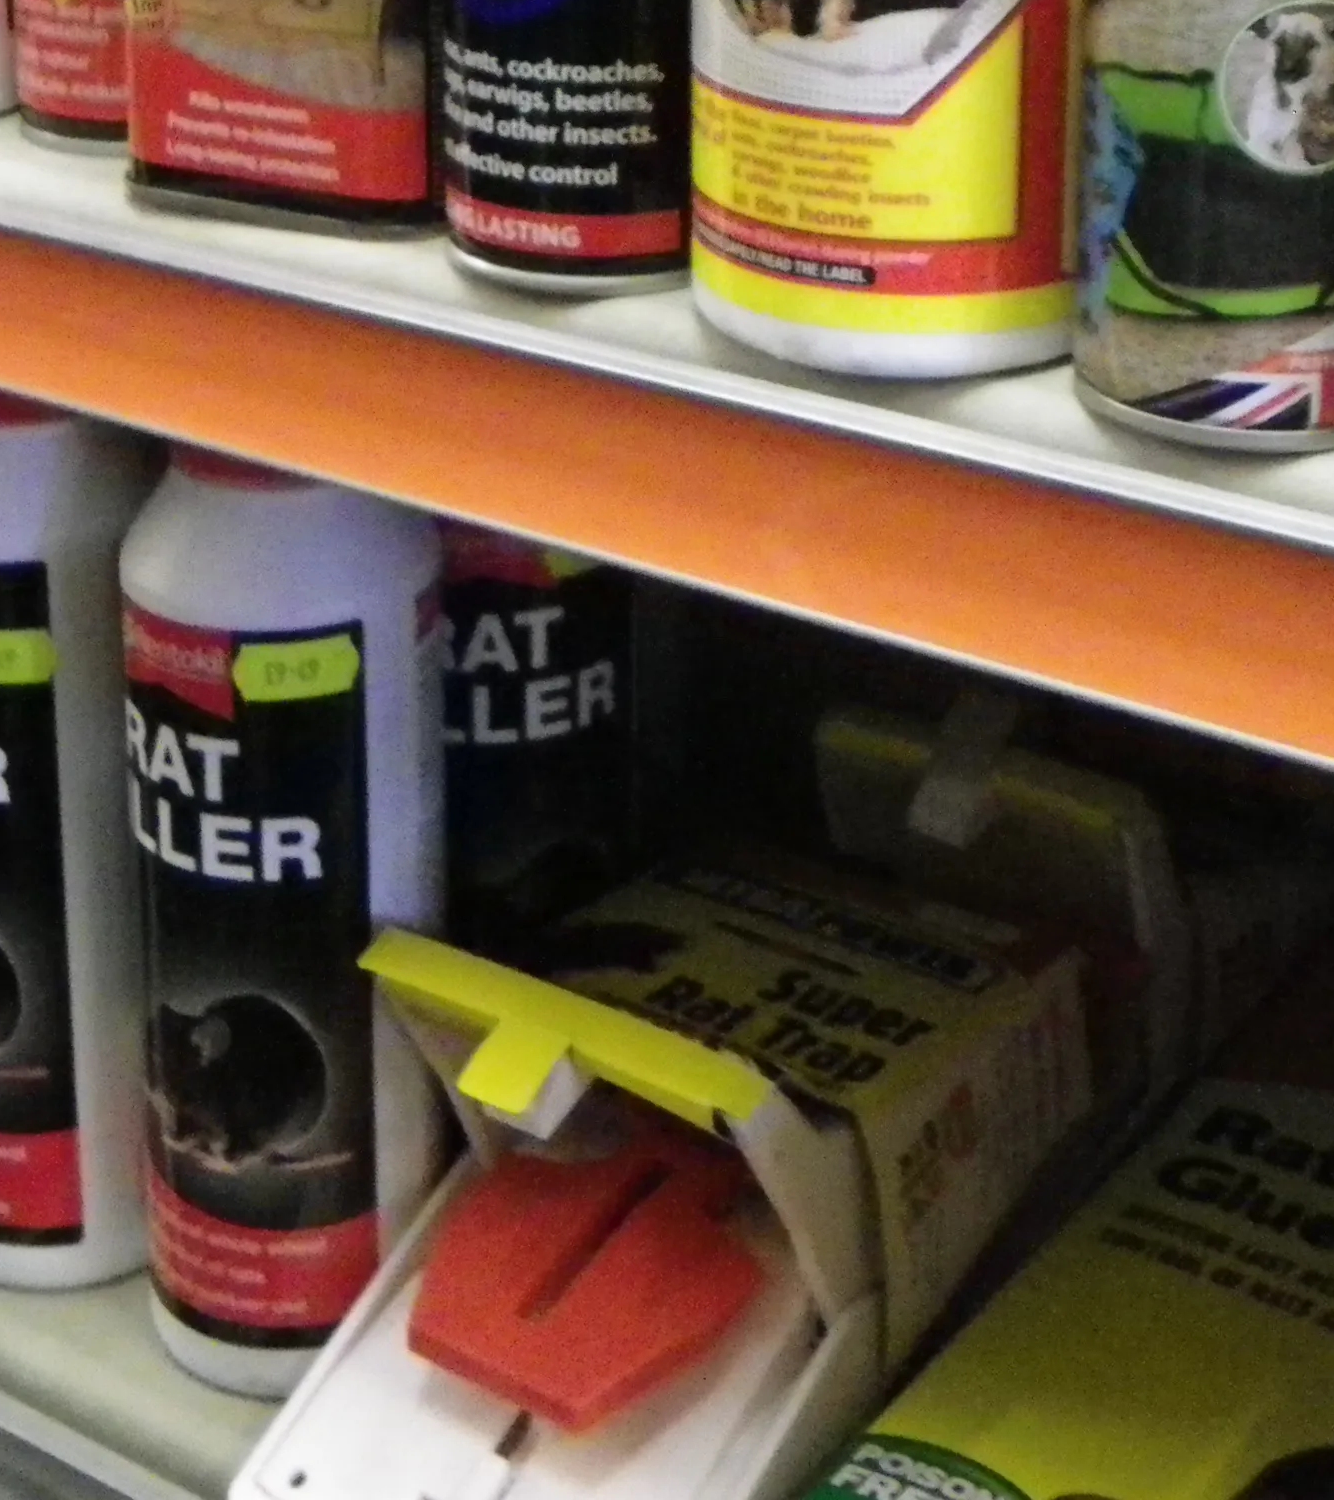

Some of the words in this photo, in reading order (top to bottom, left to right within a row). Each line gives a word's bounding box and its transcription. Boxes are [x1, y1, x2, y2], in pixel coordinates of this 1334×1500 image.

[506, 57, 666, 84] cockroaches,
[554, 87, 655, 113] beetles,
[495, 116, 560, 145] other
[563, 121, 658, 146] insects.
[527, 161, 619, 187] control
[797, 206, 874, 230] home
[756, 968, 936, 1048] Super
[758, 1014, 888, 1085] Trap
